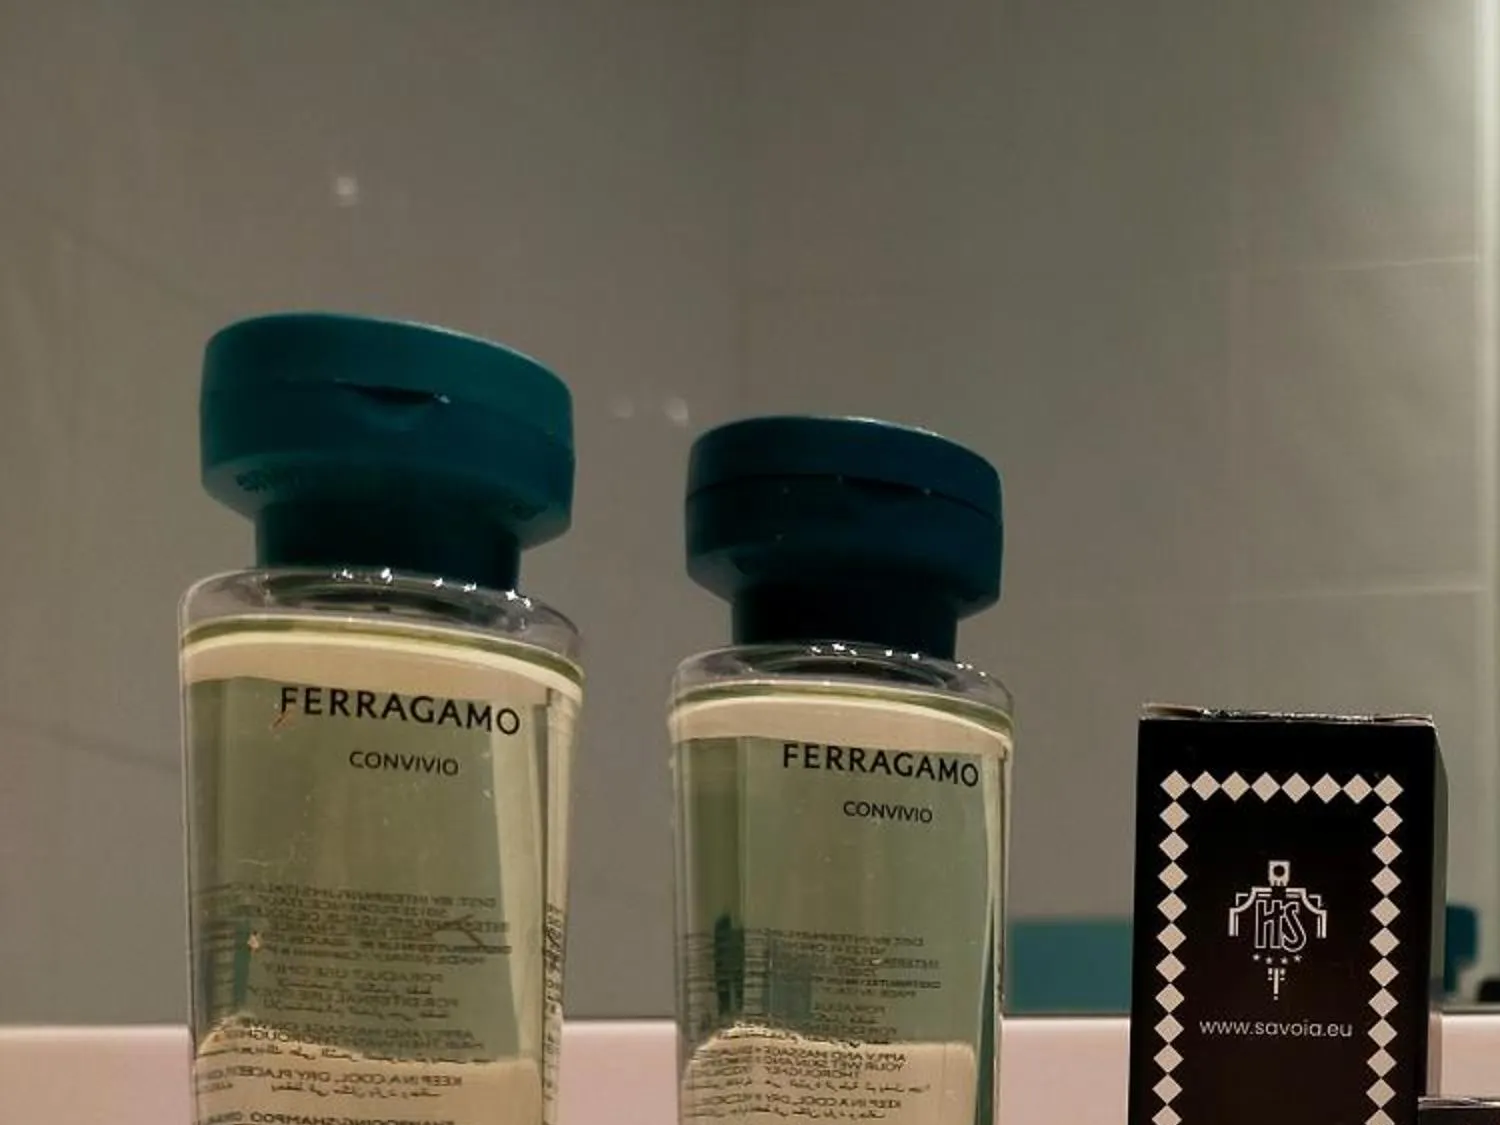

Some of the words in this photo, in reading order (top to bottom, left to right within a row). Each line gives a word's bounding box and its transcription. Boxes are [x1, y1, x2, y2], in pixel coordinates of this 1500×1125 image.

[281, 687, 520, 735] FERRAGAMO
[349, 751, 459, 776] CONVIVIO
[783, 743, 979, 787] FERRAGAMO
[843, 801, 932, 824] CONVIVIO
[1199, 1020, 1353, 1037] www.savoia.eu
